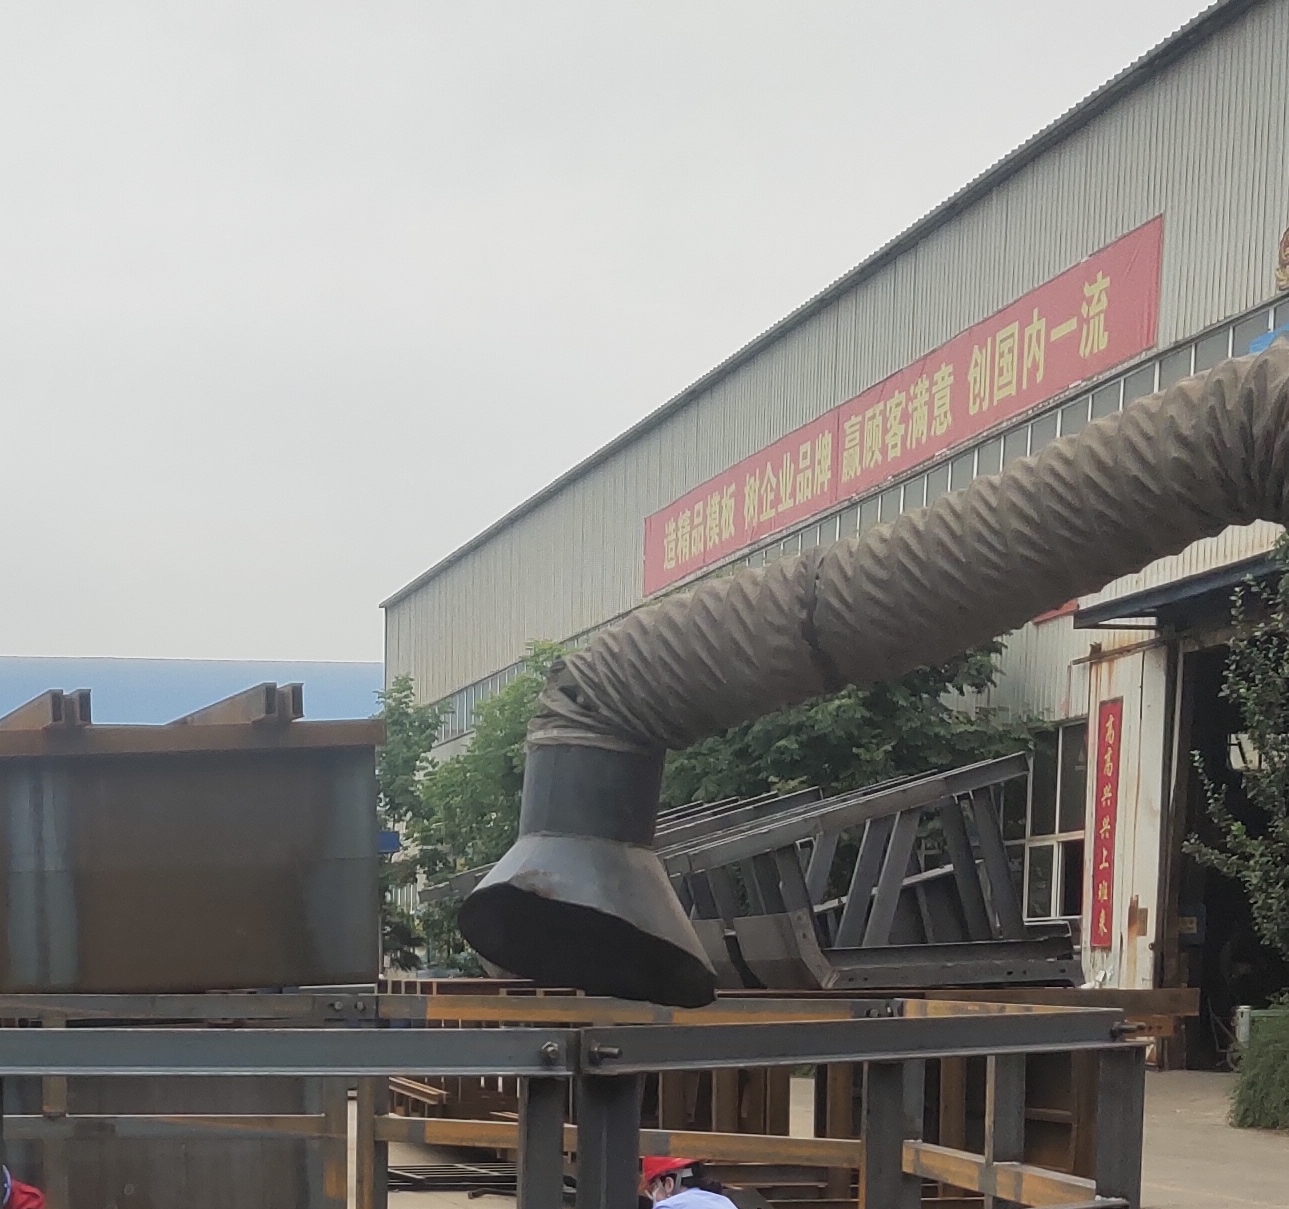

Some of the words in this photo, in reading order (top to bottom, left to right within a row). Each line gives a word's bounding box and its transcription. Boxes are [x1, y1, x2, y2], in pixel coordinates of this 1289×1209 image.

[662, 485, 736, 571] 造精品模板
[742, 431, 833, 531] 树企业品牌
[841, 364, 954, 482] 赢顾客满意
[967, 271, 1111, 415] 创国内一流
[1097, 715, 1115, 937] 高高兴兴上班来
